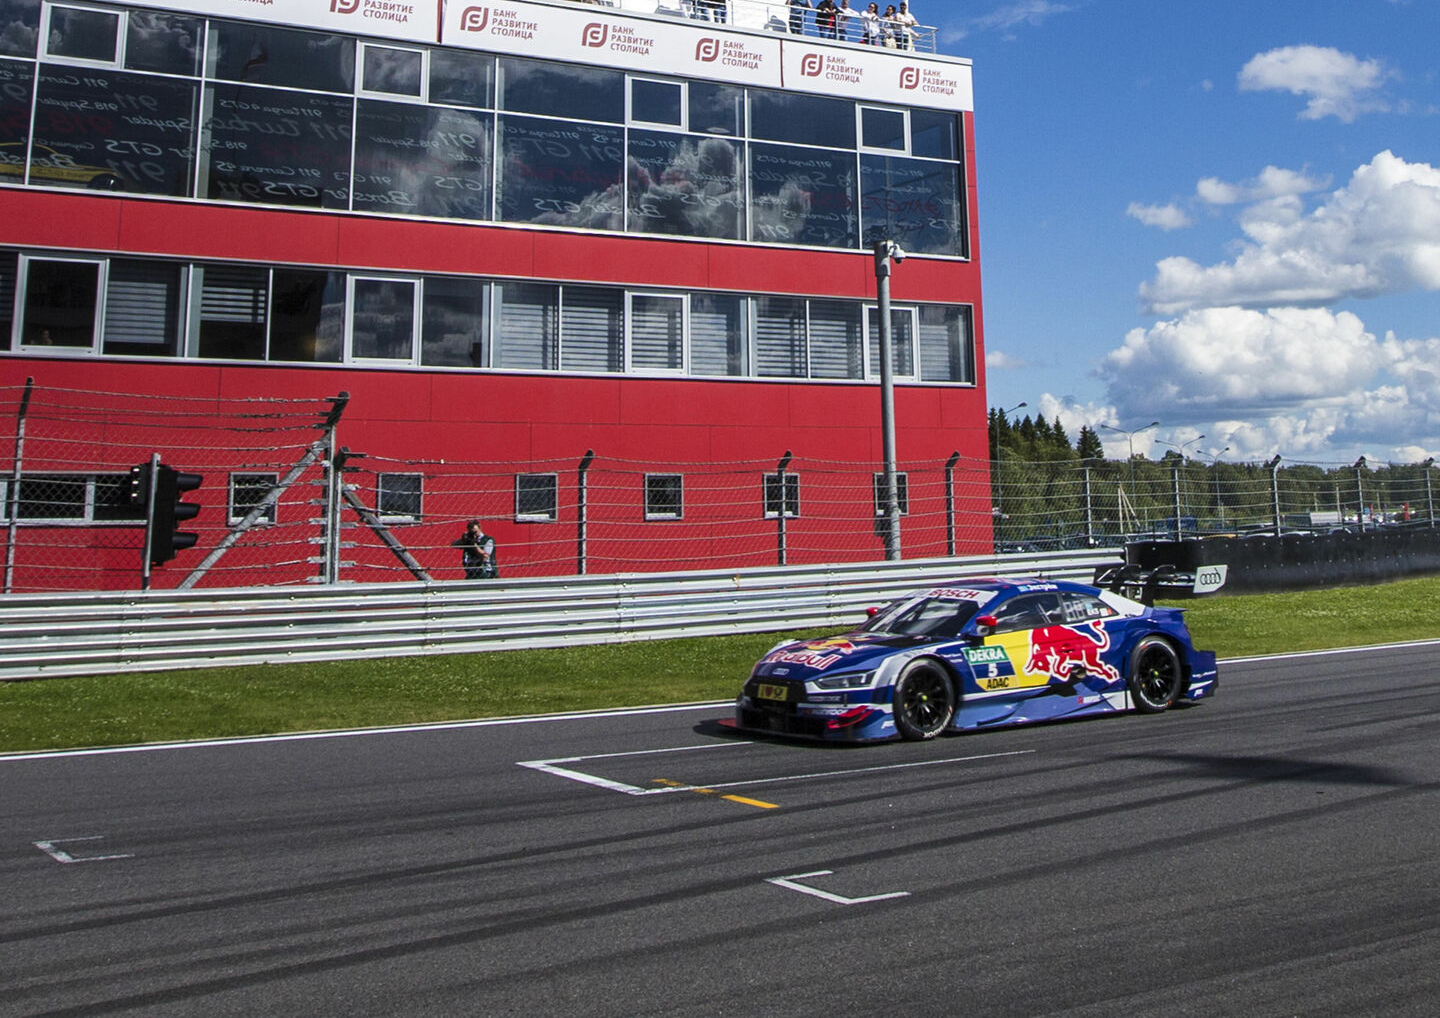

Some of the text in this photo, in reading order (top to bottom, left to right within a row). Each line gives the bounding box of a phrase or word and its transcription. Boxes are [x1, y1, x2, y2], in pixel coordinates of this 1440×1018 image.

[364, 1, 413, 14] РАЗВИТИЕ
[363, 10, 408, 23] СТОЛИЦА
[493, 9, 518, 19] БАНК
[492, 18, 538, 31] РАЗВИТИЕ
[612, 25, 634, 35] БАНК
[491, 26, 533, 39] СТОЛИЦА
[611, 34, 654, 47] РАЗВИТИЕ
[723, 40, 744, 50] БАНК
[610, 43, 650, 55] СТОЛИЦА
[722, 49, 763, 61] РАЗВИТИЕ
[722, 57, 759, 69] СТОЛИЦА
[827, 56, 846, 65] БАНК
[826, 64, 863, 76] РАЗВИТИЕ
[923, 69, 941, 78] БАНК
[825, 73, 860, 83] СТОЛИЦА
[923, 77, 957, 88] РАЗВИТИЕ
[922, 86, 954, 96] СТОЛИЦА
[929, 589, 980, 599] BOSCH
[796, 654, 842, 670] Bull
[968, 650, 1005, 662] DEKRA
[988, 663, 998, 677] 5
[986, 677, 1009, 689] ADAC
